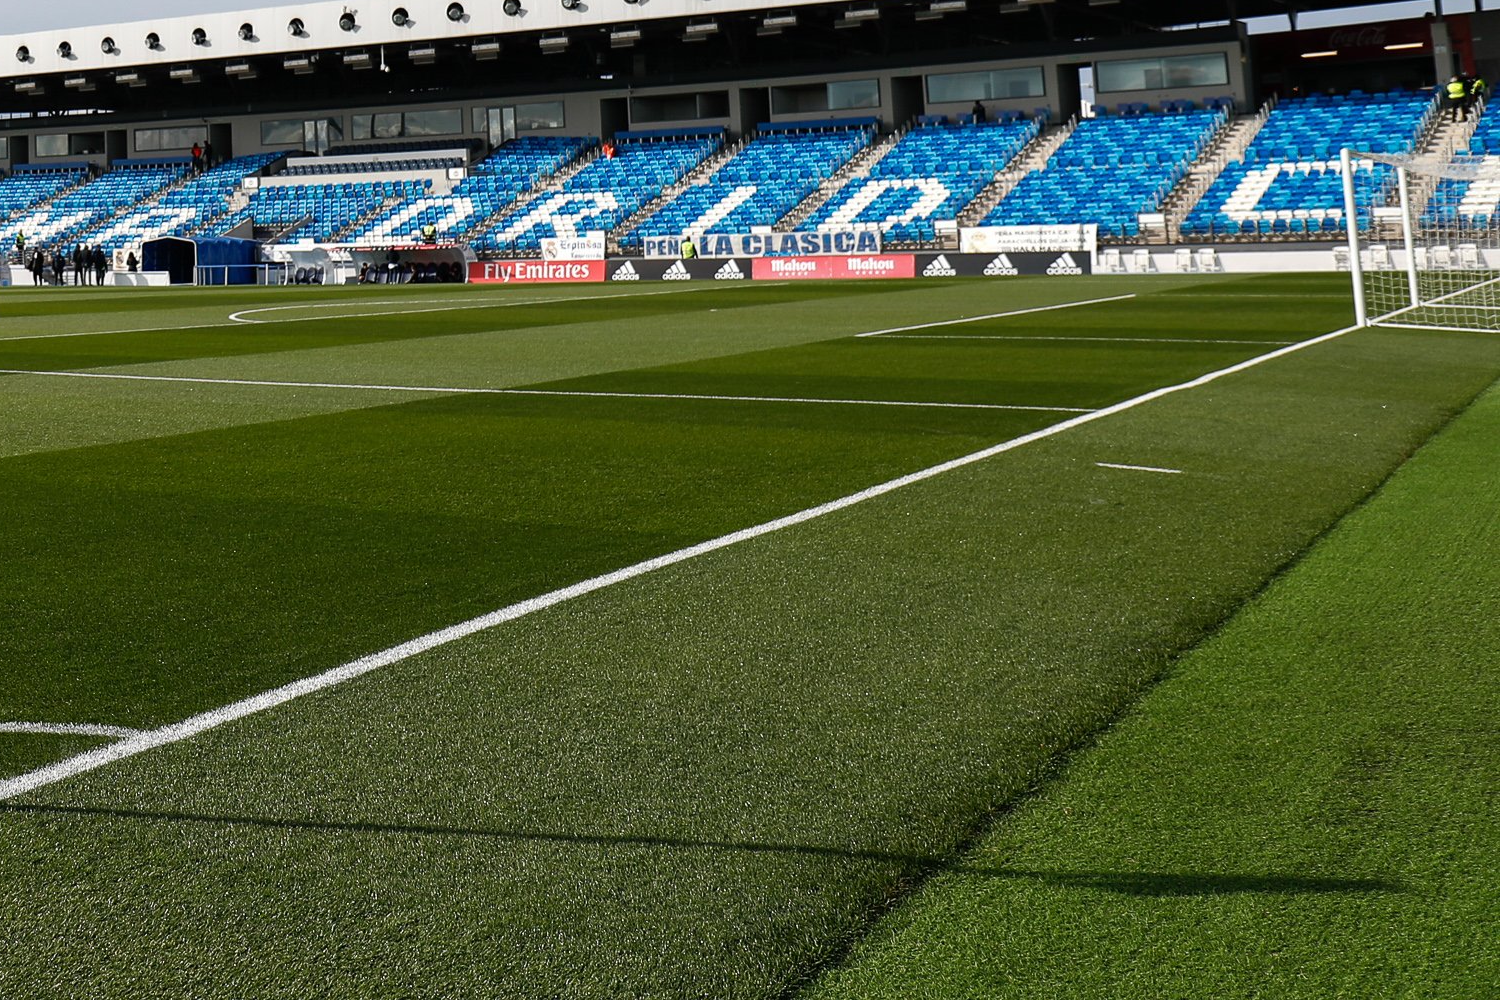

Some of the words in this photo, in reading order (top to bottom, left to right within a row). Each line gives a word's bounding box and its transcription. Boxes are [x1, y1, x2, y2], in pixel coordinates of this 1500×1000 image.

[646, 236, 684, 255] PEÑ
[699, 235, 735, 256] LA
[742, 231, 878, 255] CLASICA
[771, 258, 816, 272] Mahou
[847, 257, 894, 270] Mahou
[484, 263, 512, 283] Fly
[515, 261, 589, 279] Emirates
[922, 267, 957, 277] adidas
[983, 266, 1019, 276] adidas
[1046, 266, 1083, 275] adidas
[612, 273, 640, 281] adidas
[662, 272, 691, 280] adidas
[714, 272, 744, 280] adidas
